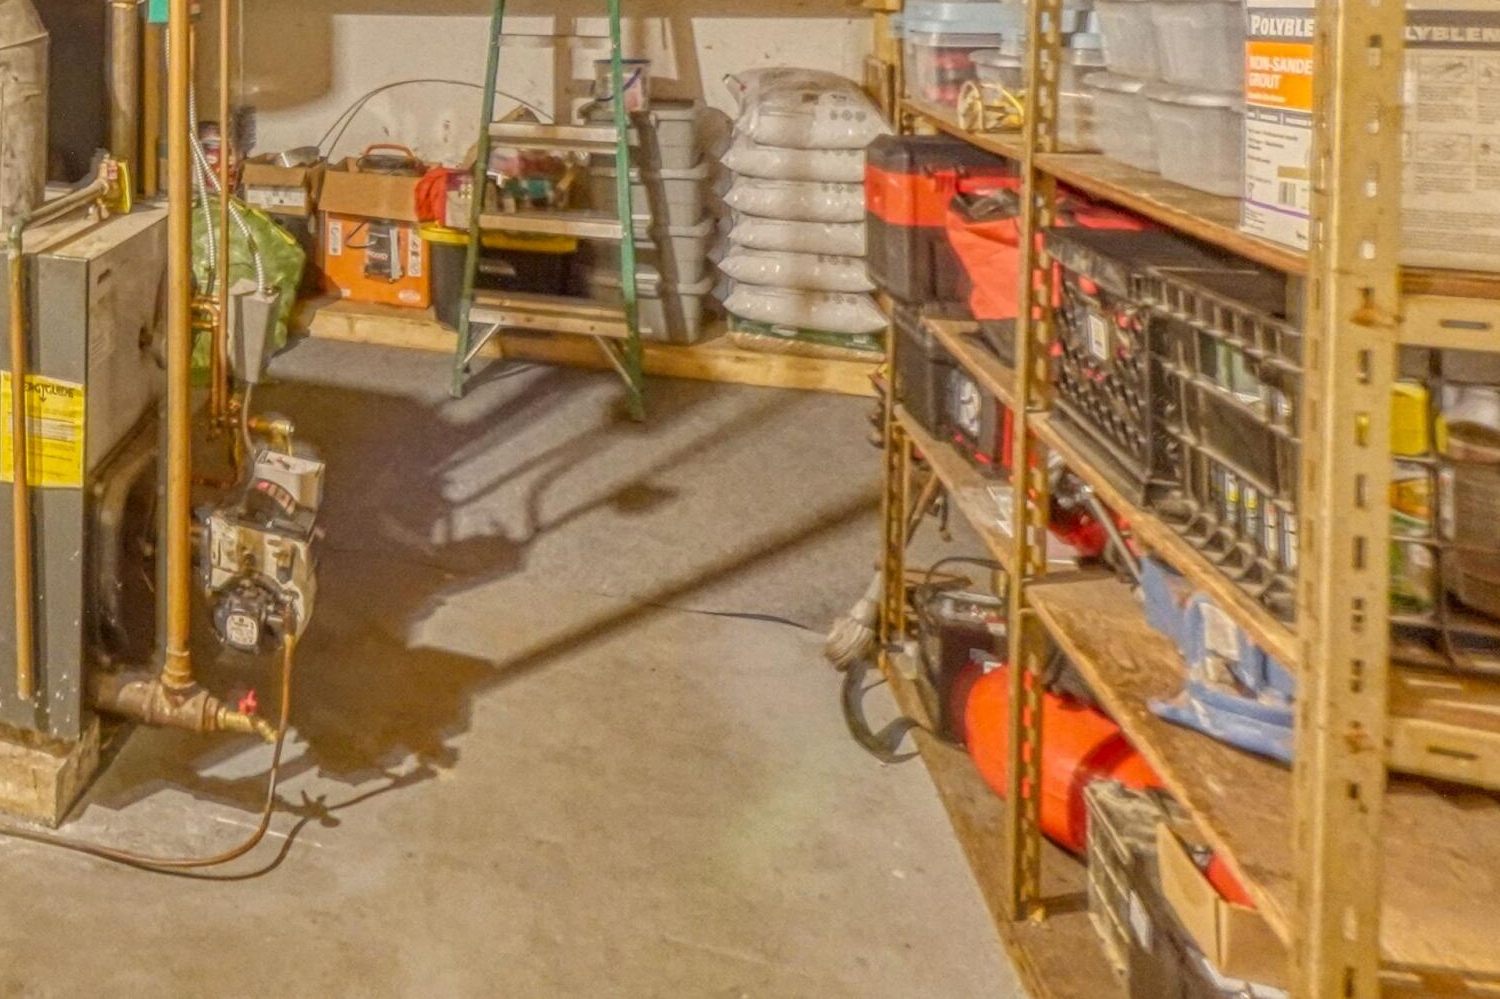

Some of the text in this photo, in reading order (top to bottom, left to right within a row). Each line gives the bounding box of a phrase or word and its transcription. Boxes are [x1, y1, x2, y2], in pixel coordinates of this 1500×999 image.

[1250, 14, 1315, 37] POLYBLE
[1405, 26, 1500, 42] LYBLEN
[1248, 56, 1314, 75] NON-SANDE
[1248, 72, 1282, 89] GROUT
